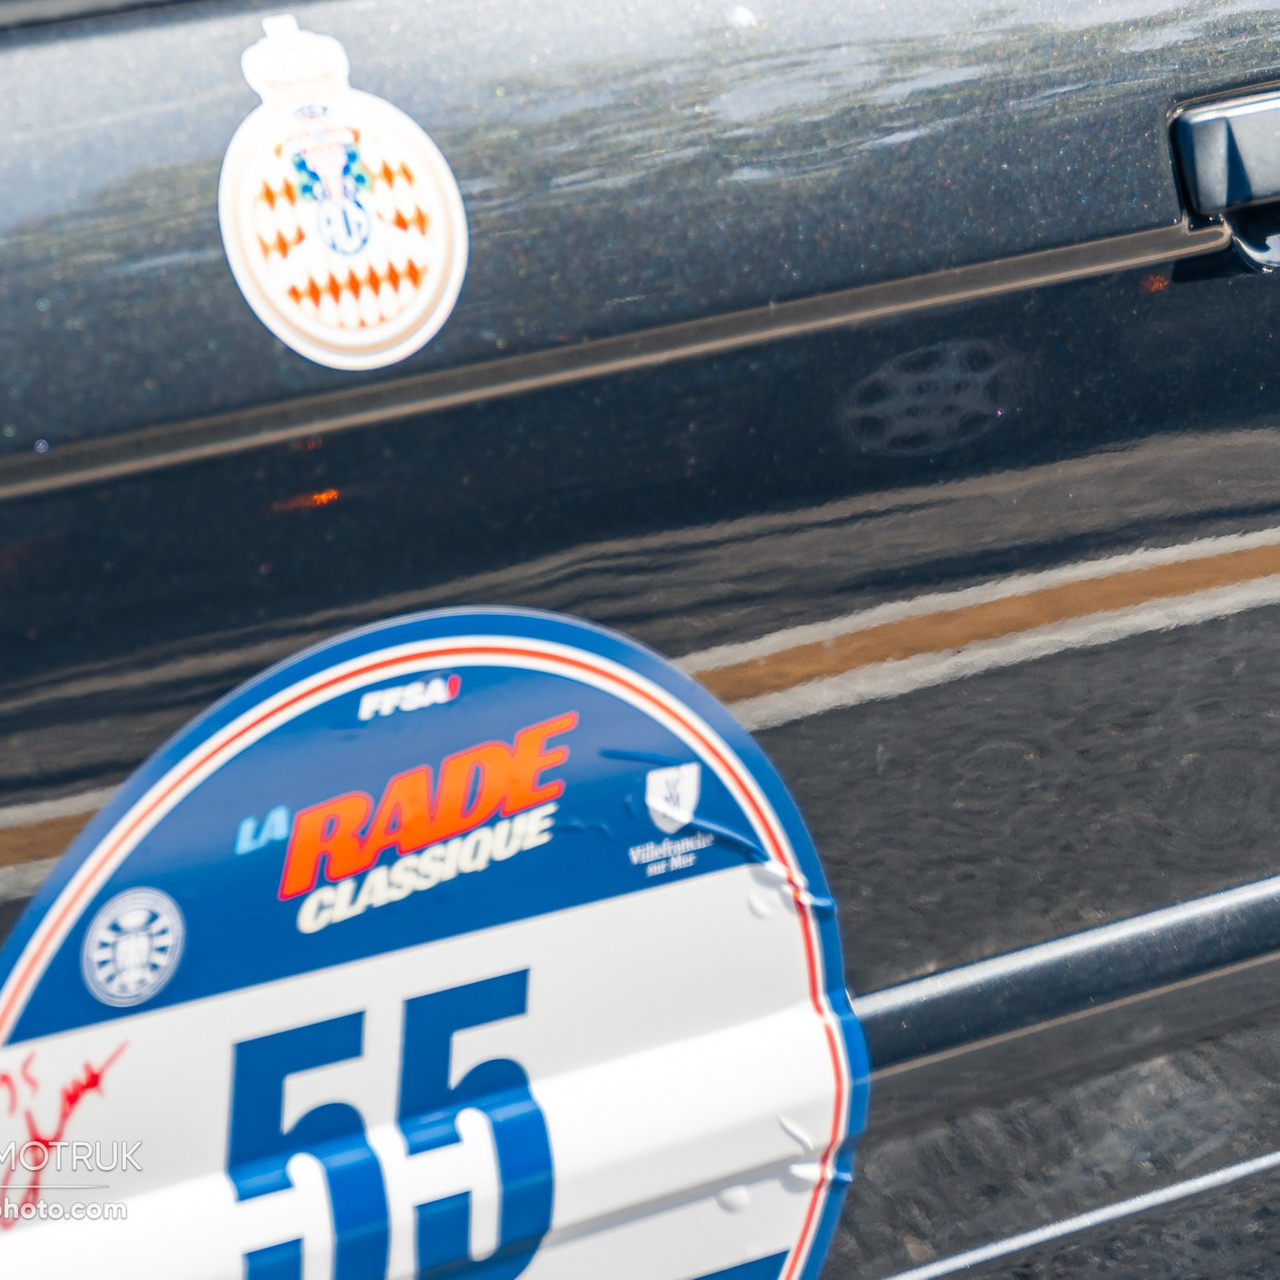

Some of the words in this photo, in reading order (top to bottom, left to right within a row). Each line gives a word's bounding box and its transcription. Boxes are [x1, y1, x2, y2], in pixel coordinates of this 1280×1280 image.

[234, 806, 291, 855] LA
[278, 711, 579, 901] RADE
[296, 802, 559, 934] CLASSIQUE
[226, 967, 555, 1280] 55
